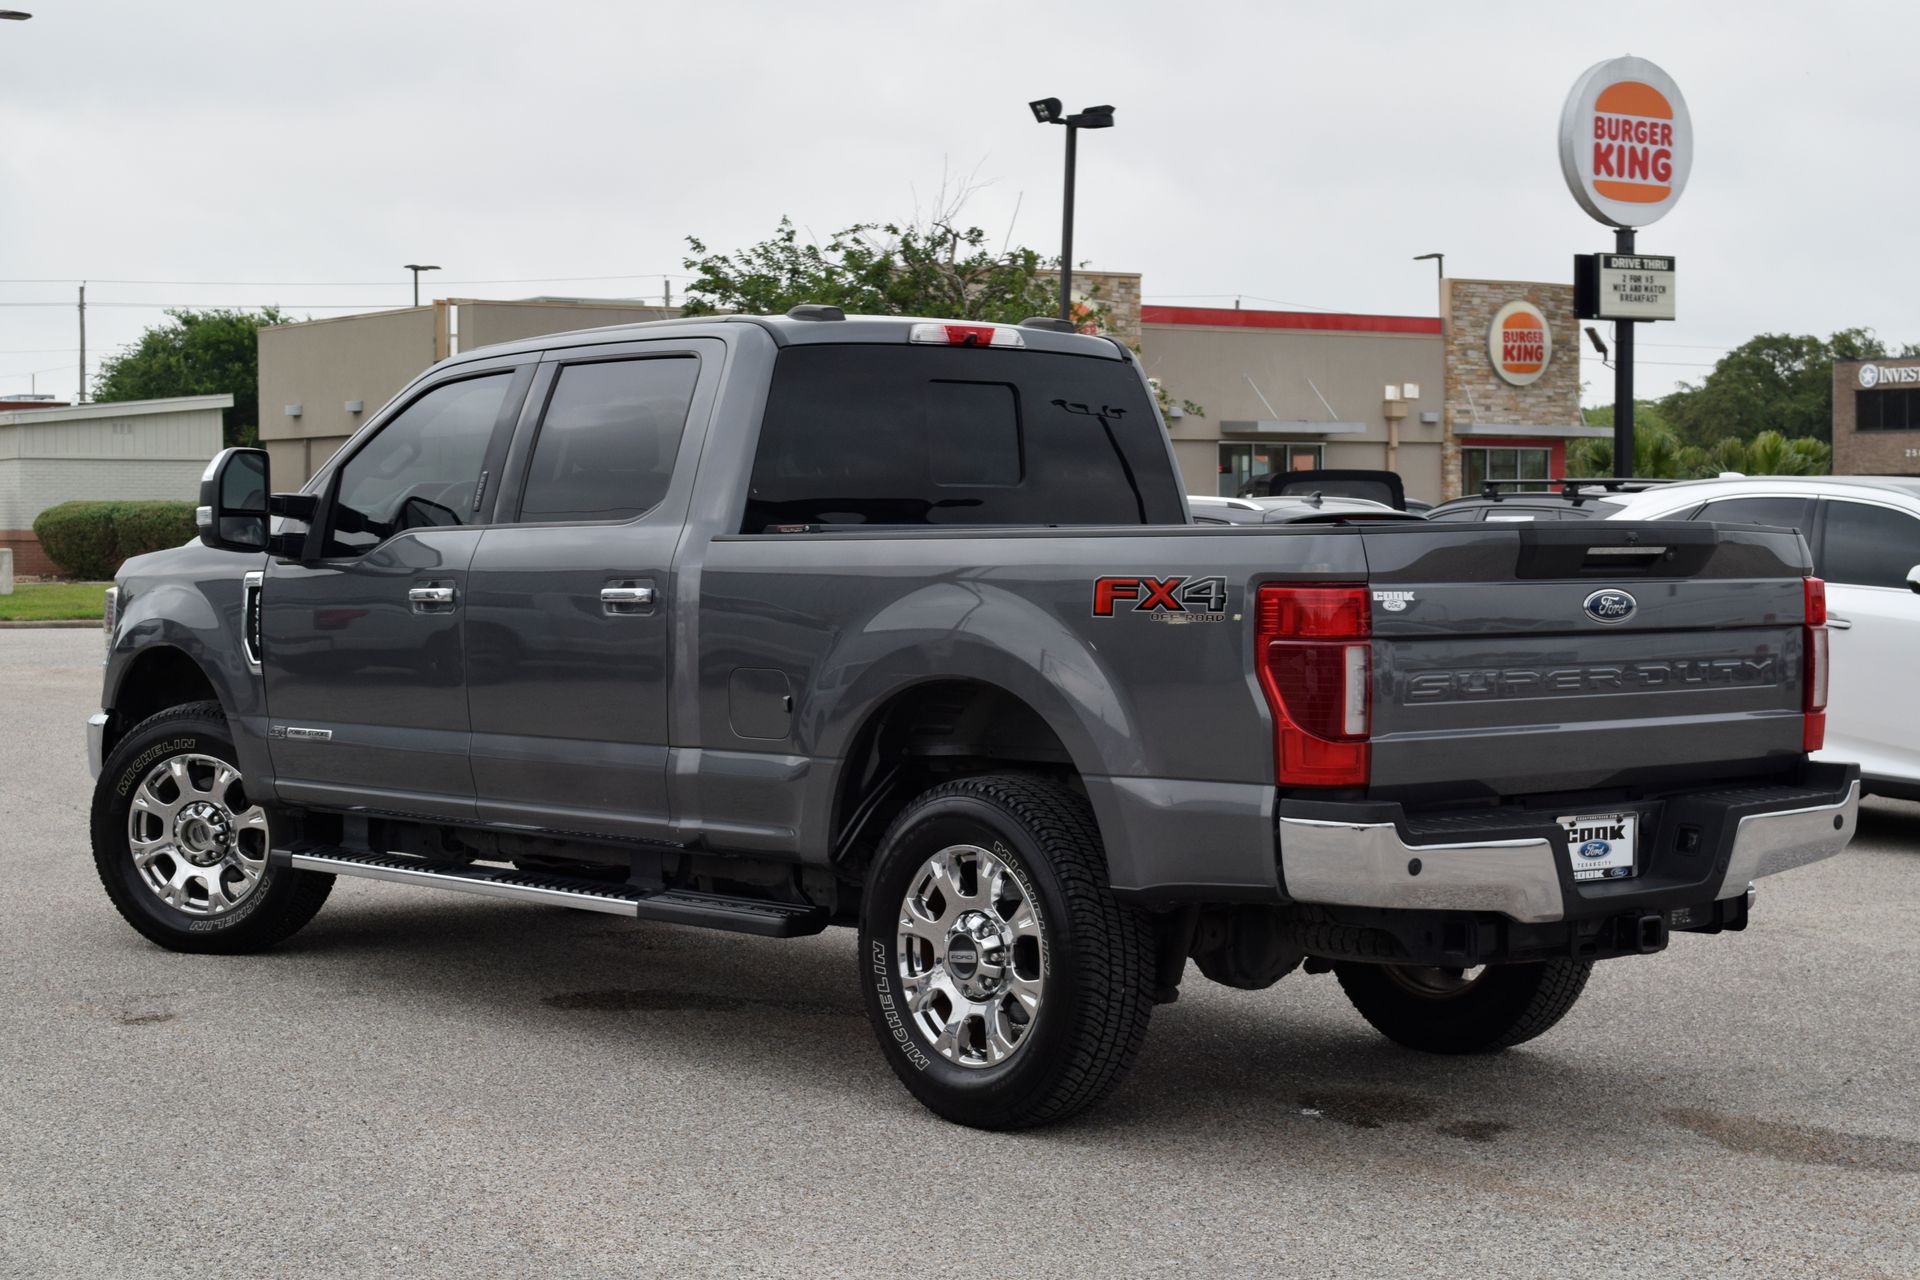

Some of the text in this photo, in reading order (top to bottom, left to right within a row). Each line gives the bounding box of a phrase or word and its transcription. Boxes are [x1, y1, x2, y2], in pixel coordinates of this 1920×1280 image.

[1593, 115, 1673, 147] BURGER
[1593, 142, 1673, 183] KING
[1611, 257, 1669, 271] DRIVE THRU
[1629, 274, 1642, 283] FOR
[1613, 284, 1666, 294] MIX AND MATCH
[1620, 293, 1658, 303] BREAKFAST
[1503, 331, 1544, 343] BURGER
[1503, 344, 1544, 362] KING
[1092, 575, 1228, 618] FX4
[1372, 591, 1416, 601] COOK
[1597, 595, 1627, 615] Ford
[1185, 613, 1226, 623] ROAD
[1410, 657, 1774, 697] SUPER DUTY
[117, 738, 196, 796] MICHELIN
[1565, 825, 1626, 844] COOK
[1585, 843, 1605, 857] Ford
[189, 876, 272, 932] MICHELIN
[993, 840, 1050, 976] MICHELIN
[873, 941, 931, 1071] MICHELIN
